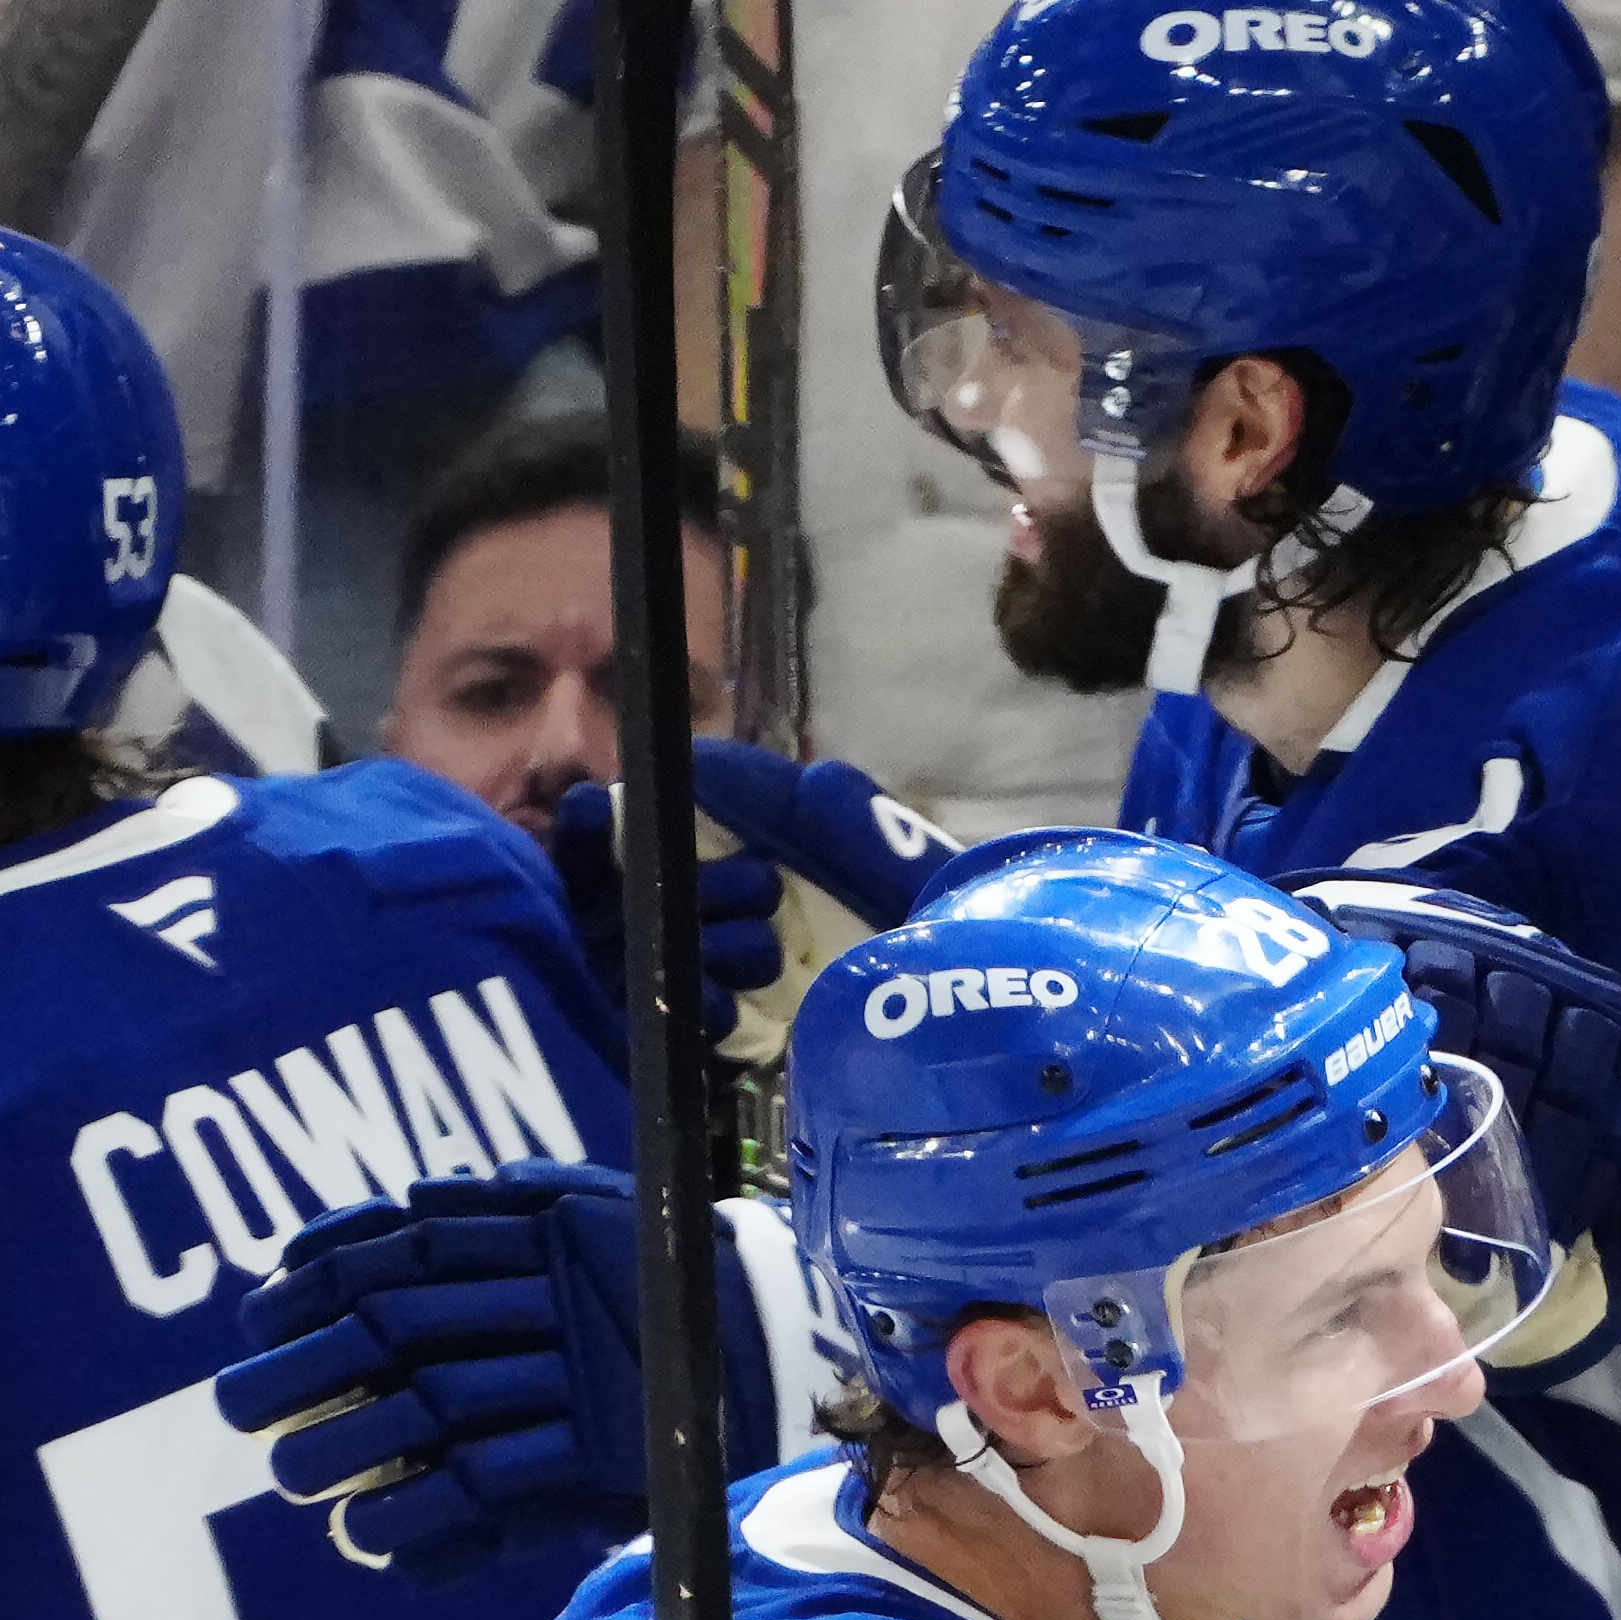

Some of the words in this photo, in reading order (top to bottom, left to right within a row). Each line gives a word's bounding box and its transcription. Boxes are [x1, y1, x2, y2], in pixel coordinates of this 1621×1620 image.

[1140, 12, 1394, 63] OREO
[103, 477, 156, 585] 53
[1197, 896, 1330, 986] 28
[863, 967, 1079, 1040] OREO
[1324, 992, 1414, 1088] BAUER
[70, 976, 586, 1318] COWAN
